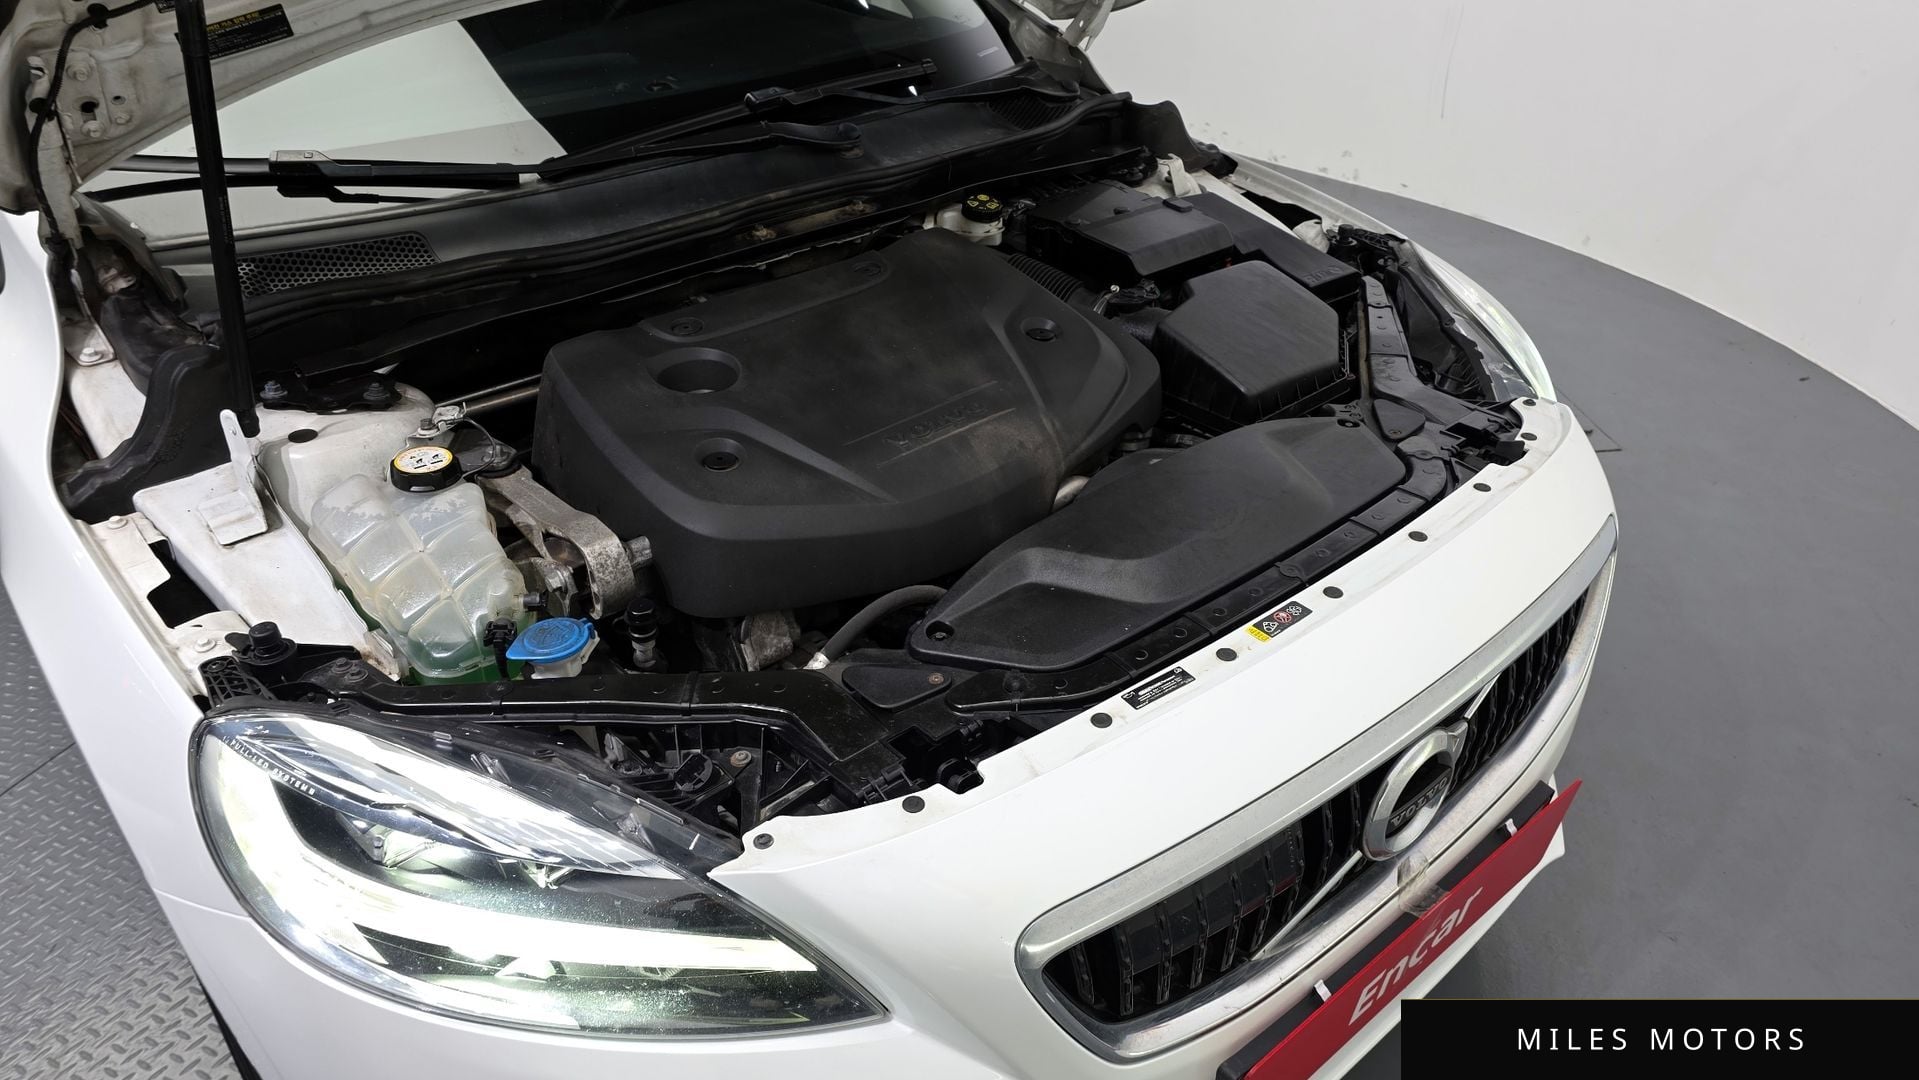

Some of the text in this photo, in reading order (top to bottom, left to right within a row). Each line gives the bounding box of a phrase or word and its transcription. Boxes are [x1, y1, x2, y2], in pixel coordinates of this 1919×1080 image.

[882, 402, 988, 450] VOLVO
[1390, 777, 1448, 827] VOLVO
[1348, 886, 1484, 1026] Encar
